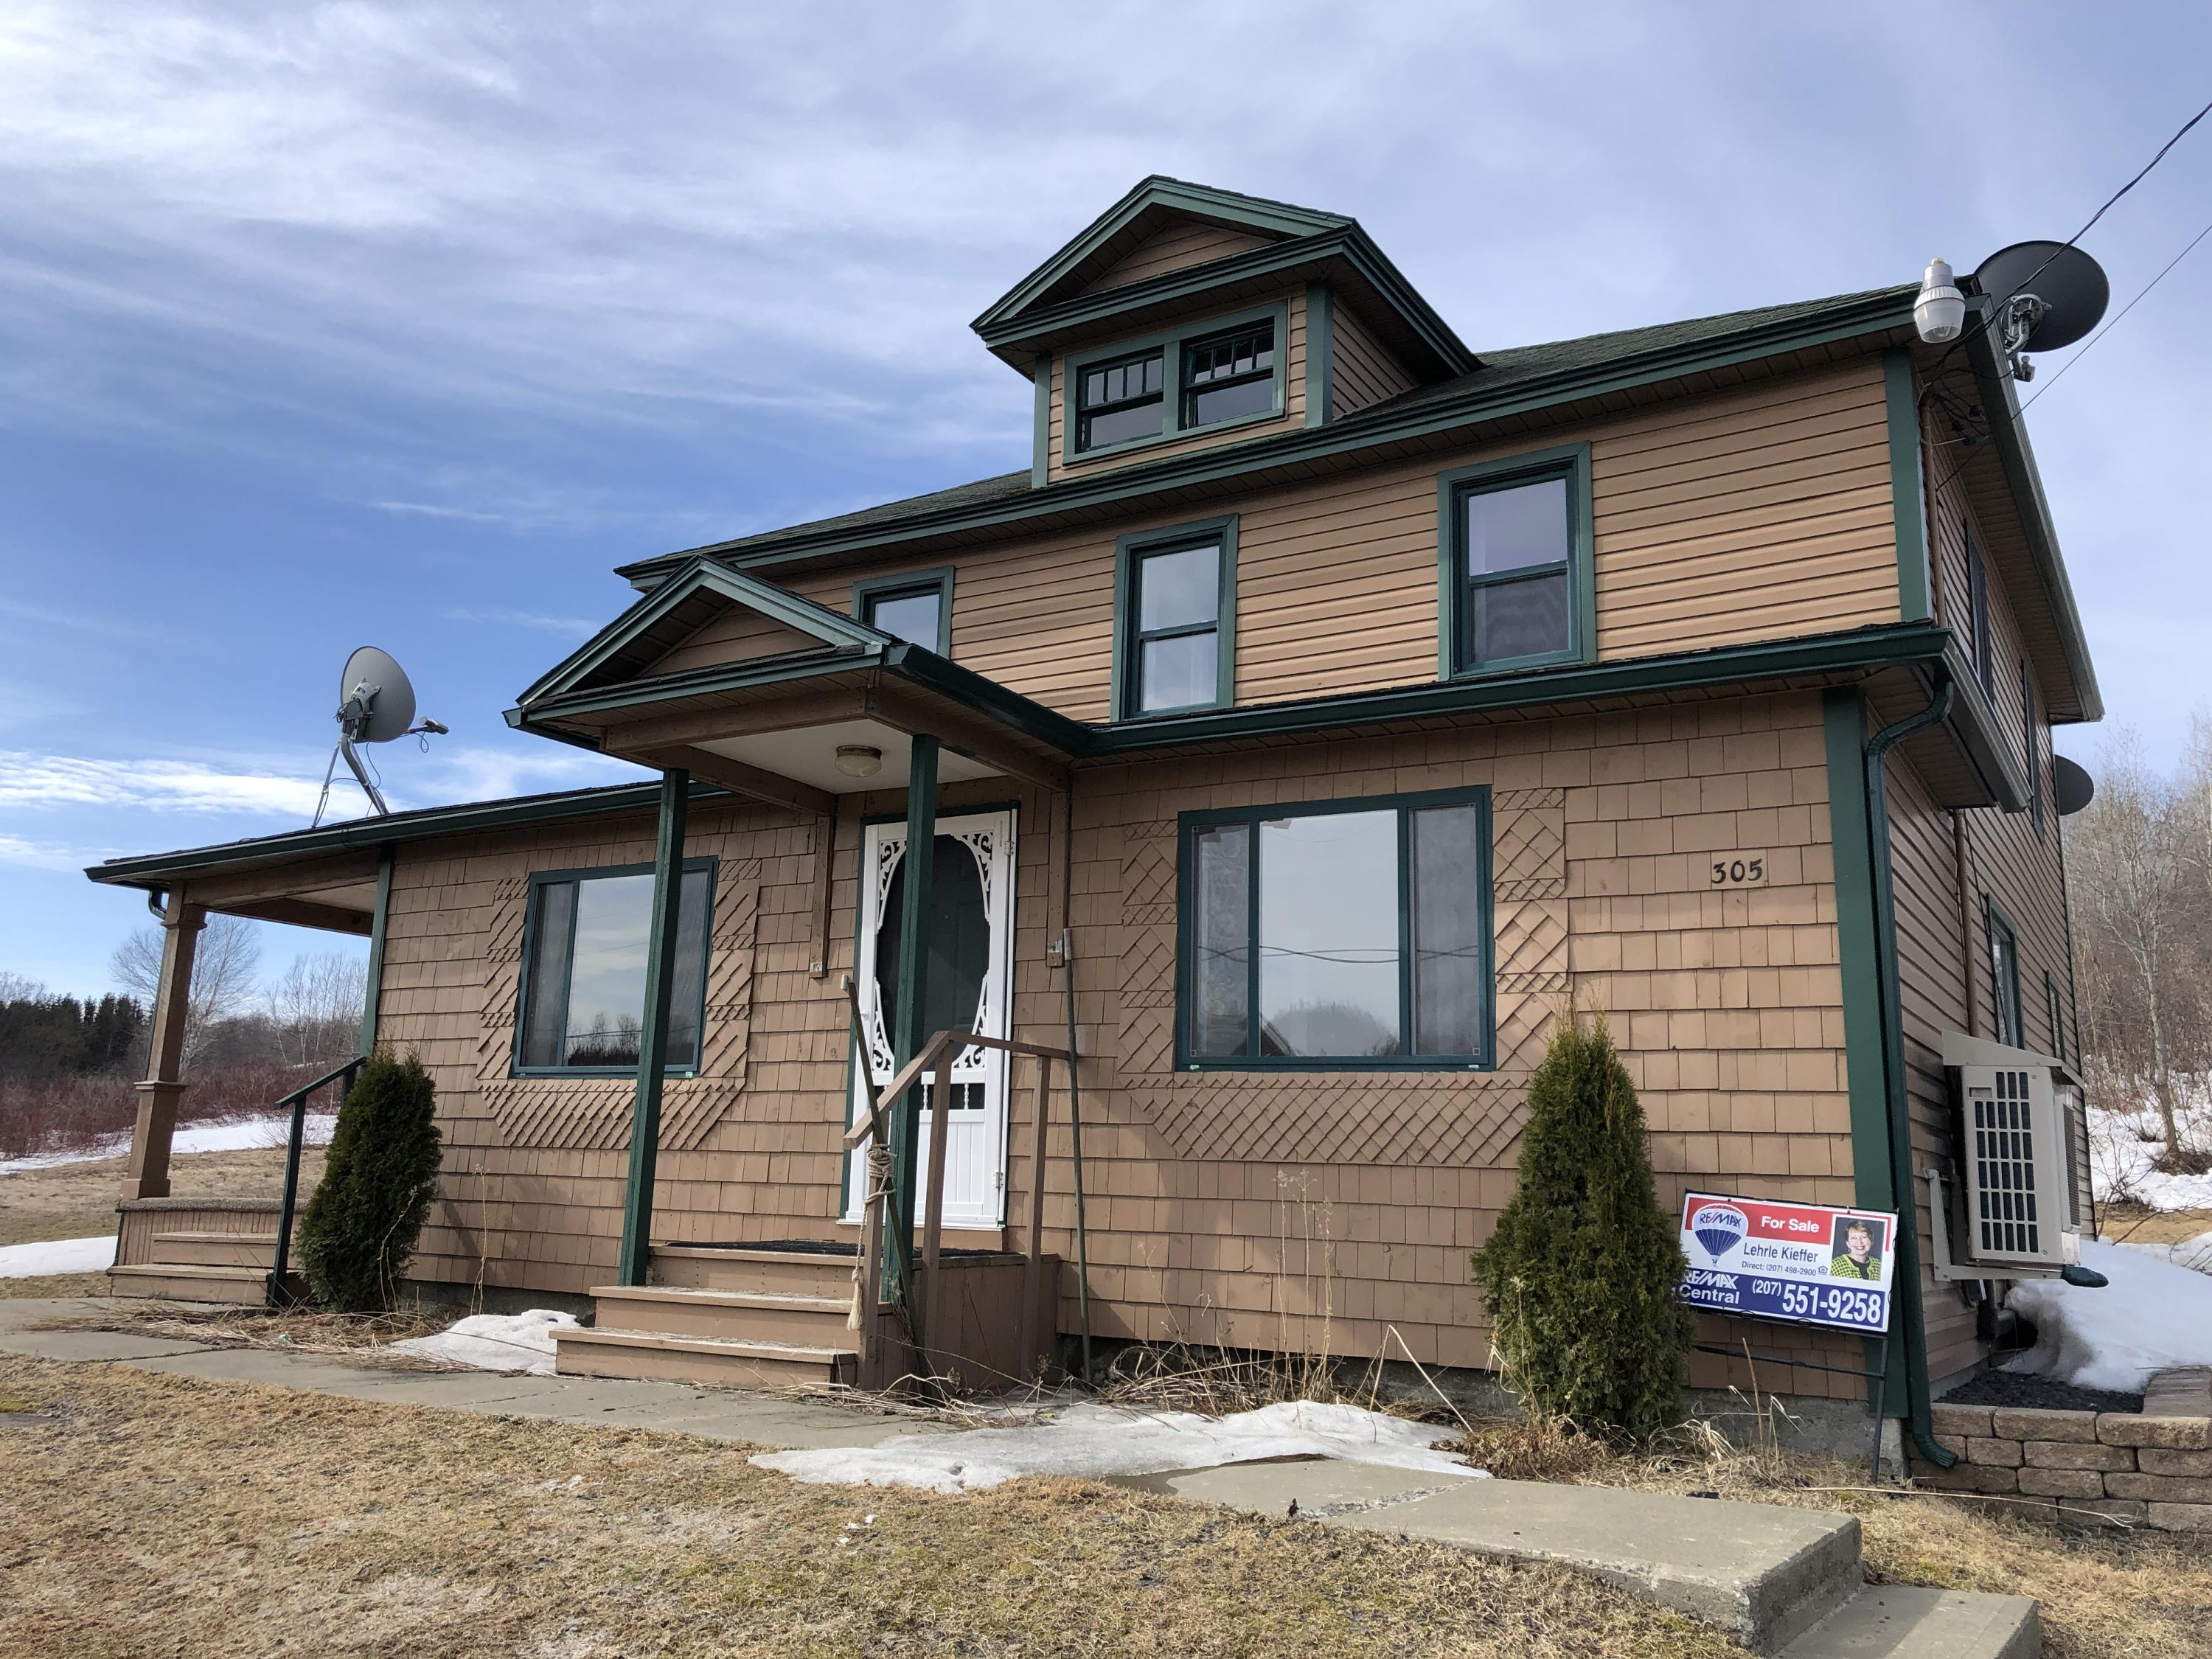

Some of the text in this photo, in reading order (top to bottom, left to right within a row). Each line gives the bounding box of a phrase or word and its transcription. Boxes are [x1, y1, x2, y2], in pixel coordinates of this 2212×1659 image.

[1711, 858, 1762, 884] 305
[1700, 1212, 1742, 1228] RE/MAX
[1761, 1215, 1820, 1233] For Sale
[1744, 1242, 1818, 1262] Lehrle Kieffer
[1742, 1261, 1817, 1276] Direct: (207) 498-2900
[1679, 1284, 1740, 1304] Central
[1752, 1279, 1881, 1324] (207) 551-9258
